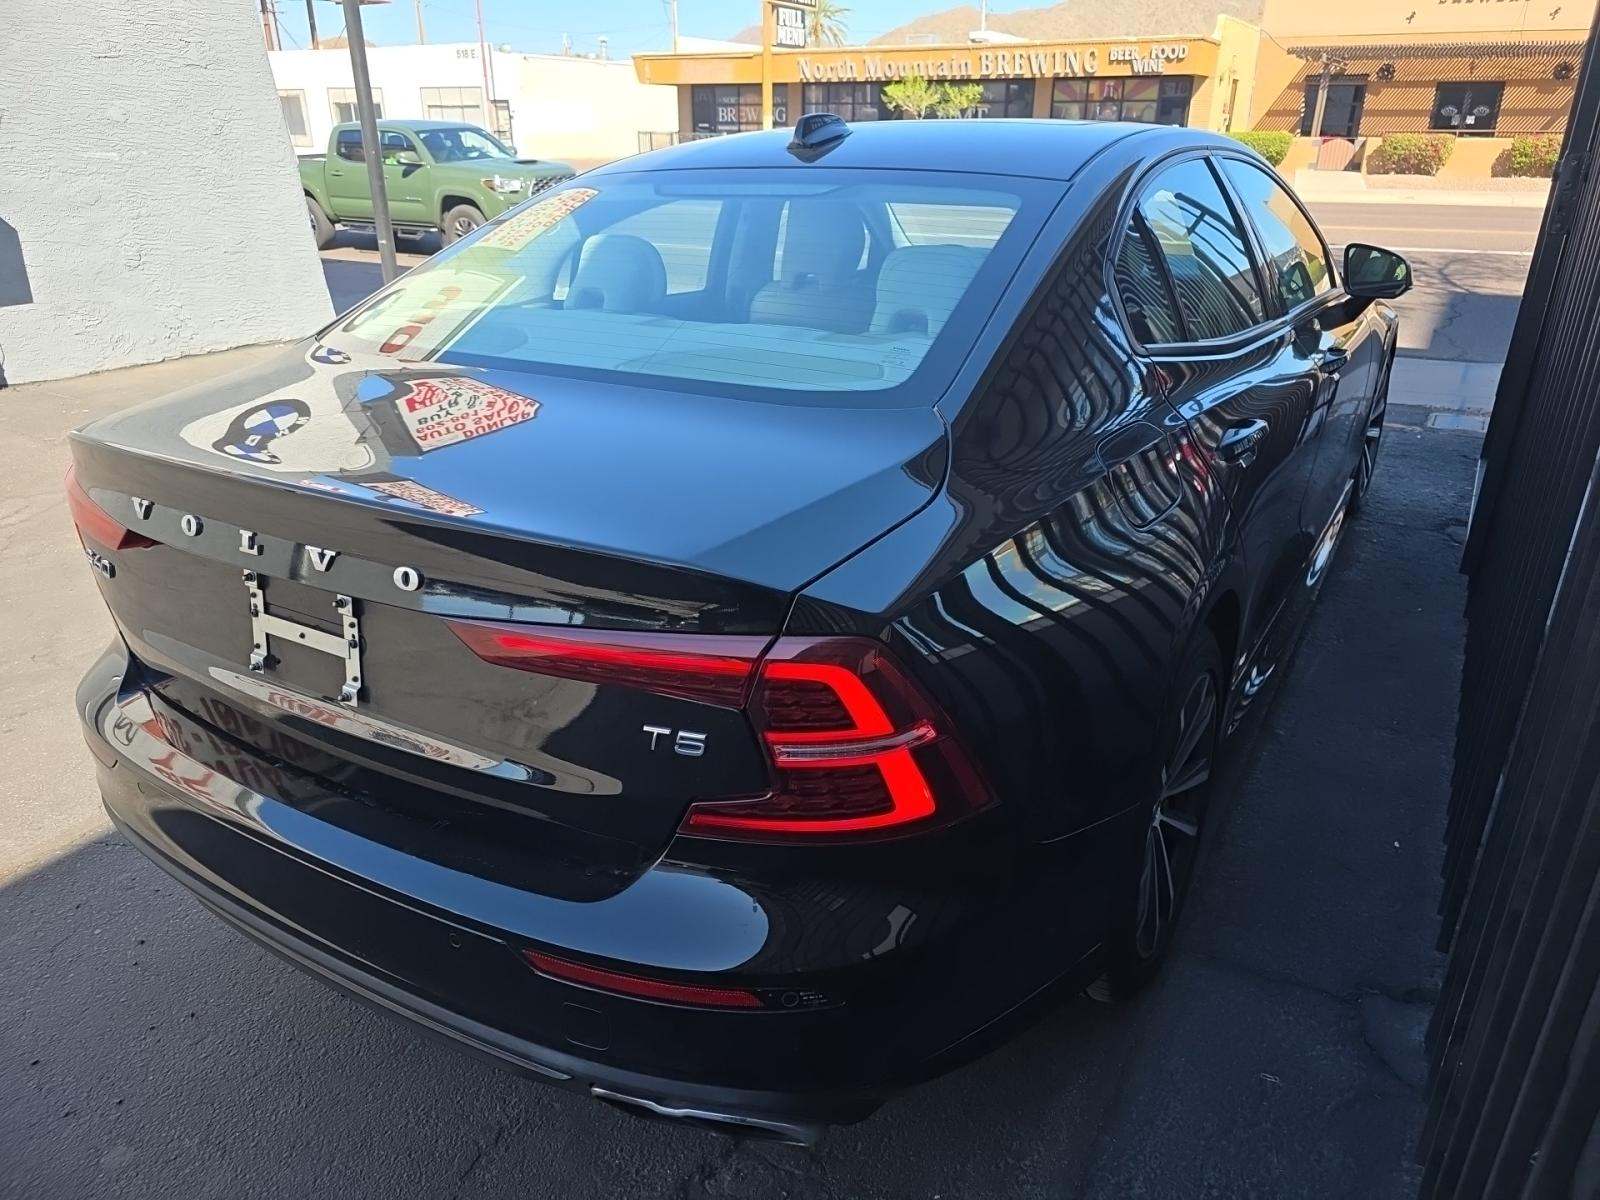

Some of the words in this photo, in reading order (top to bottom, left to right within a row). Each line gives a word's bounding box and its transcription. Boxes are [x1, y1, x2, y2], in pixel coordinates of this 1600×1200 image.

[778, 8, 804, 29] FULL
[777, 26, 805, 47] MENU
[1150, 44, 1190, 62] FOOD
[798, 57, 858, 83] North
[864, 54, 973, 81] Mountain
[980, 47, 1098, 76] BREWING
[1131, 58, 1165, 74] WINE
[718, 106, 787, 123] BREWG
[131, 496, 424, 592] VOLVO
[643, 724, 707, 756] T5
